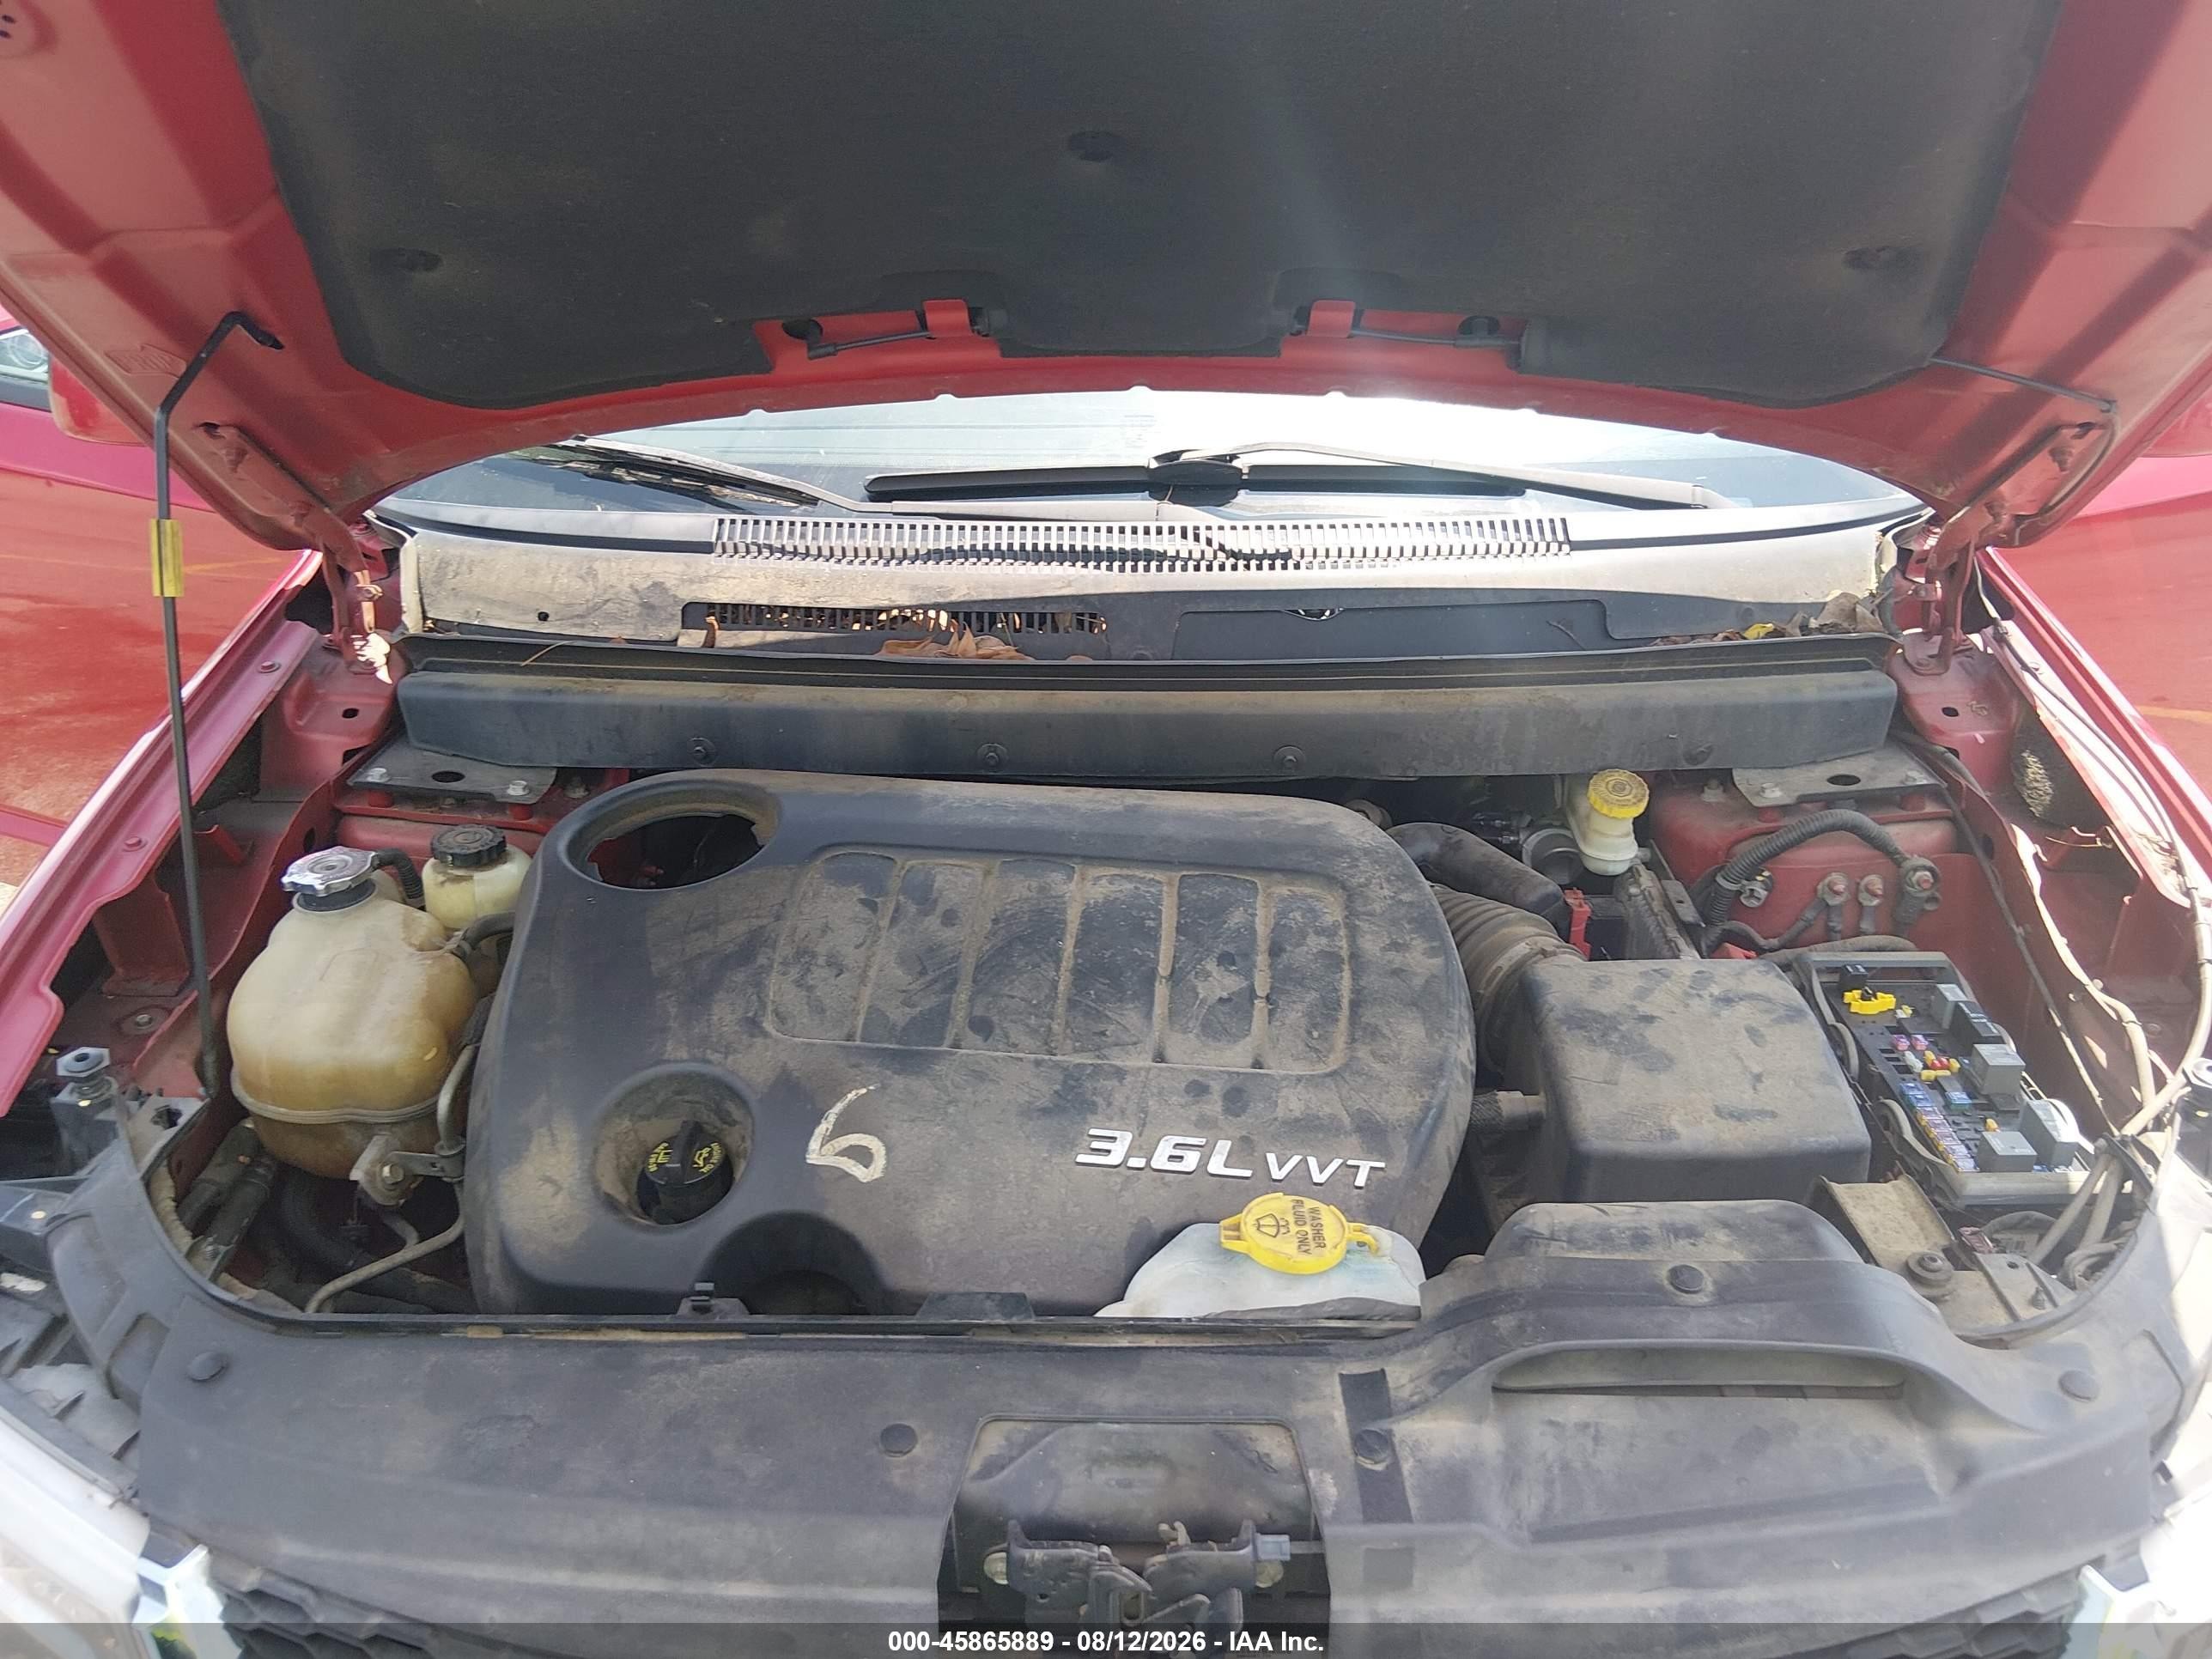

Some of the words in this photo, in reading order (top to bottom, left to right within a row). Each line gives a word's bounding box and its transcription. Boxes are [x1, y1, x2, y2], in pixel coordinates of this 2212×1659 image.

[806, 1084, 886, 1182] 6
[1075, 1128, 1254, 1178] 3.6L
[1266, 1152, 1386, 1188] VVT
[1291, 1199, 1308, 1227] FLUID
[1308, 1206, 1327, 1249] WASHER
[1295, 1230, 1312, 1255] ONLY
